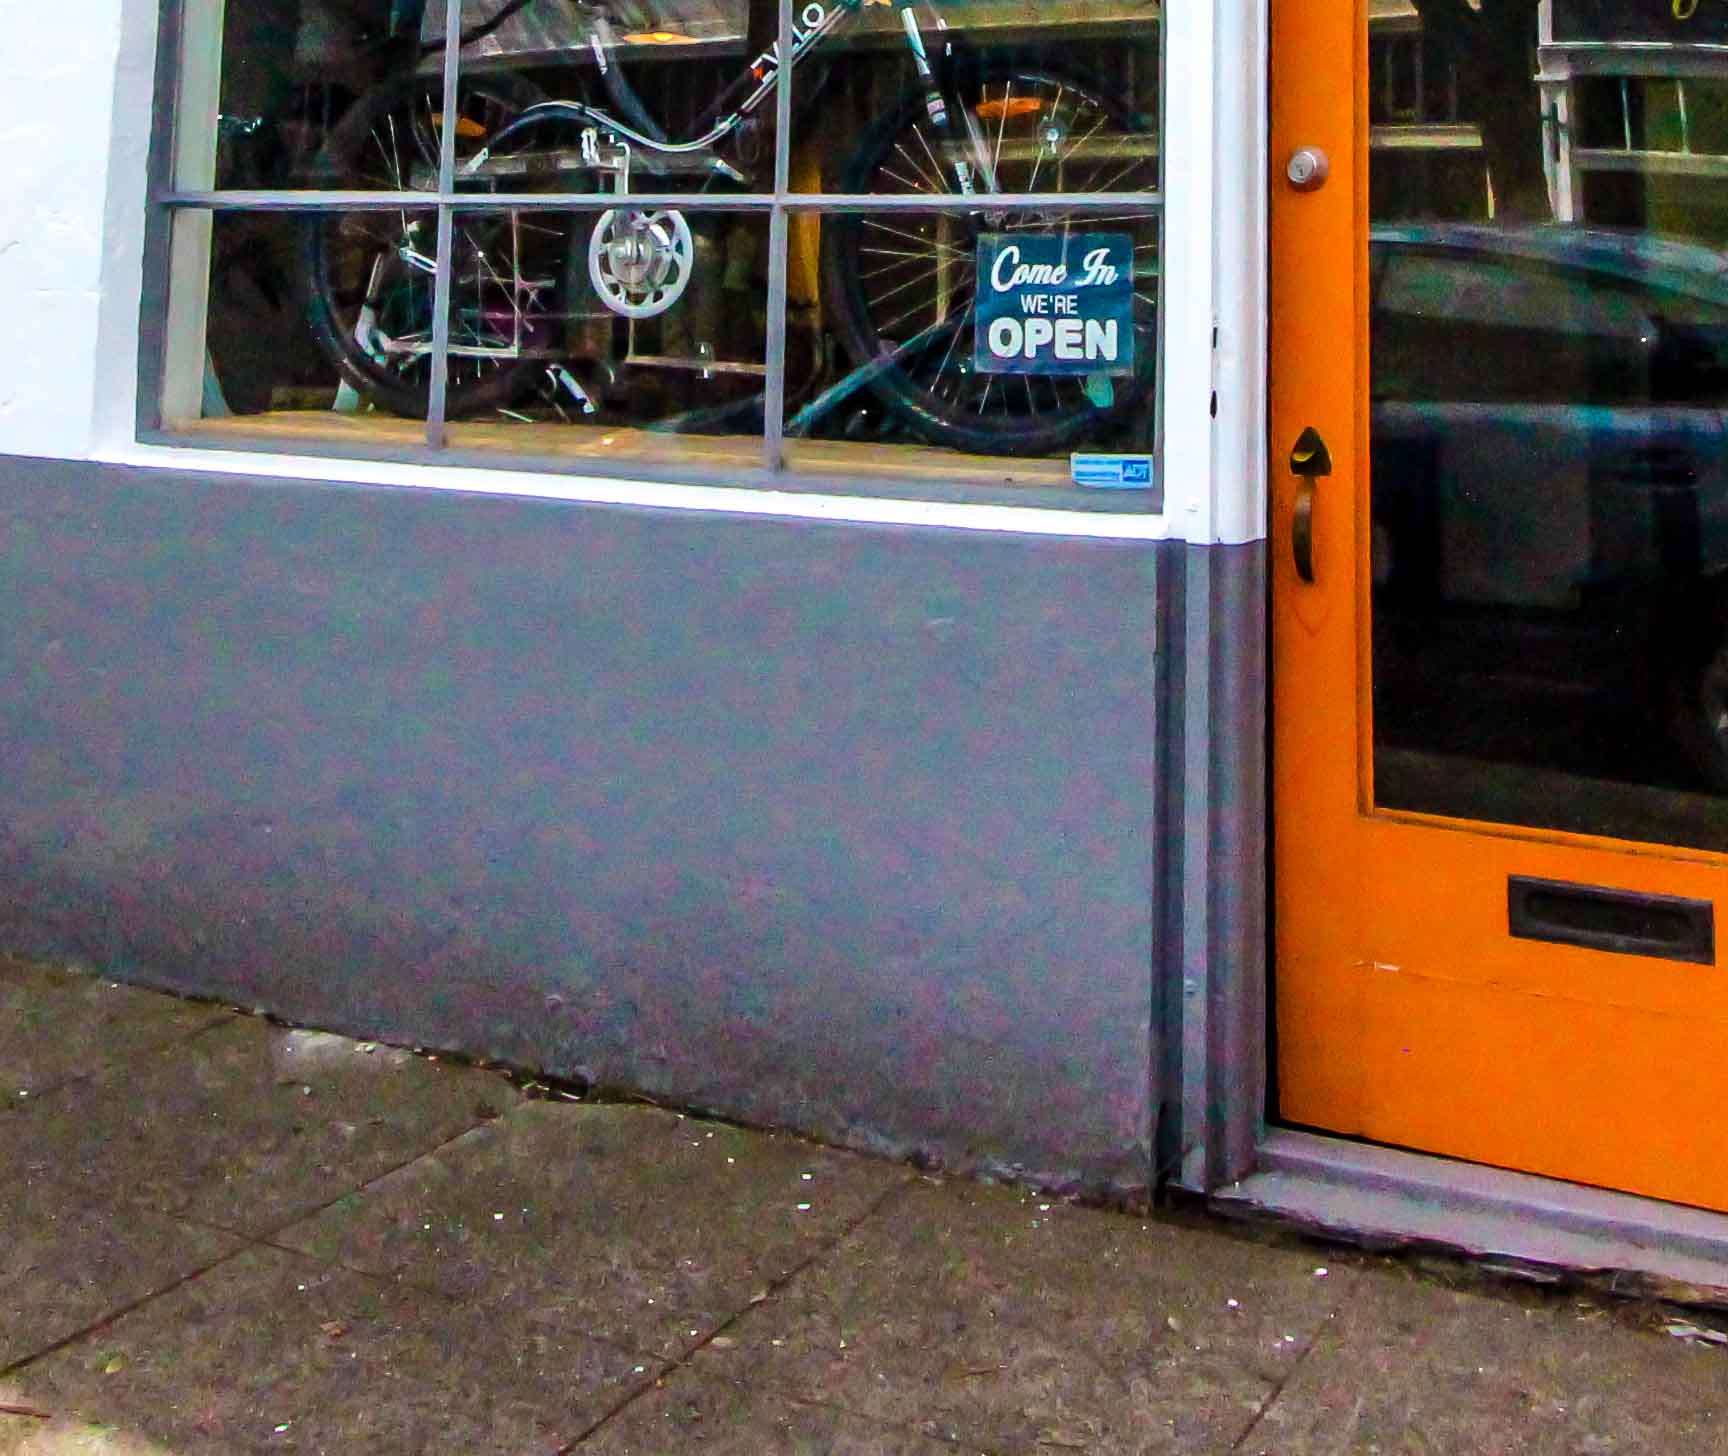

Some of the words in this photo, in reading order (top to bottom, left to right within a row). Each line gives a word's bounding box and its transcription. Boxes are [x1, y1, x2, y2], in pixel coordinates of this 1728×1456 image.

[990, 245, 1068, 293] Come
[1074, 248, 1119, 287] In
[1020, 294, 1079, 315] WE'RE
[987, 316, 1119, 361] OPEN
